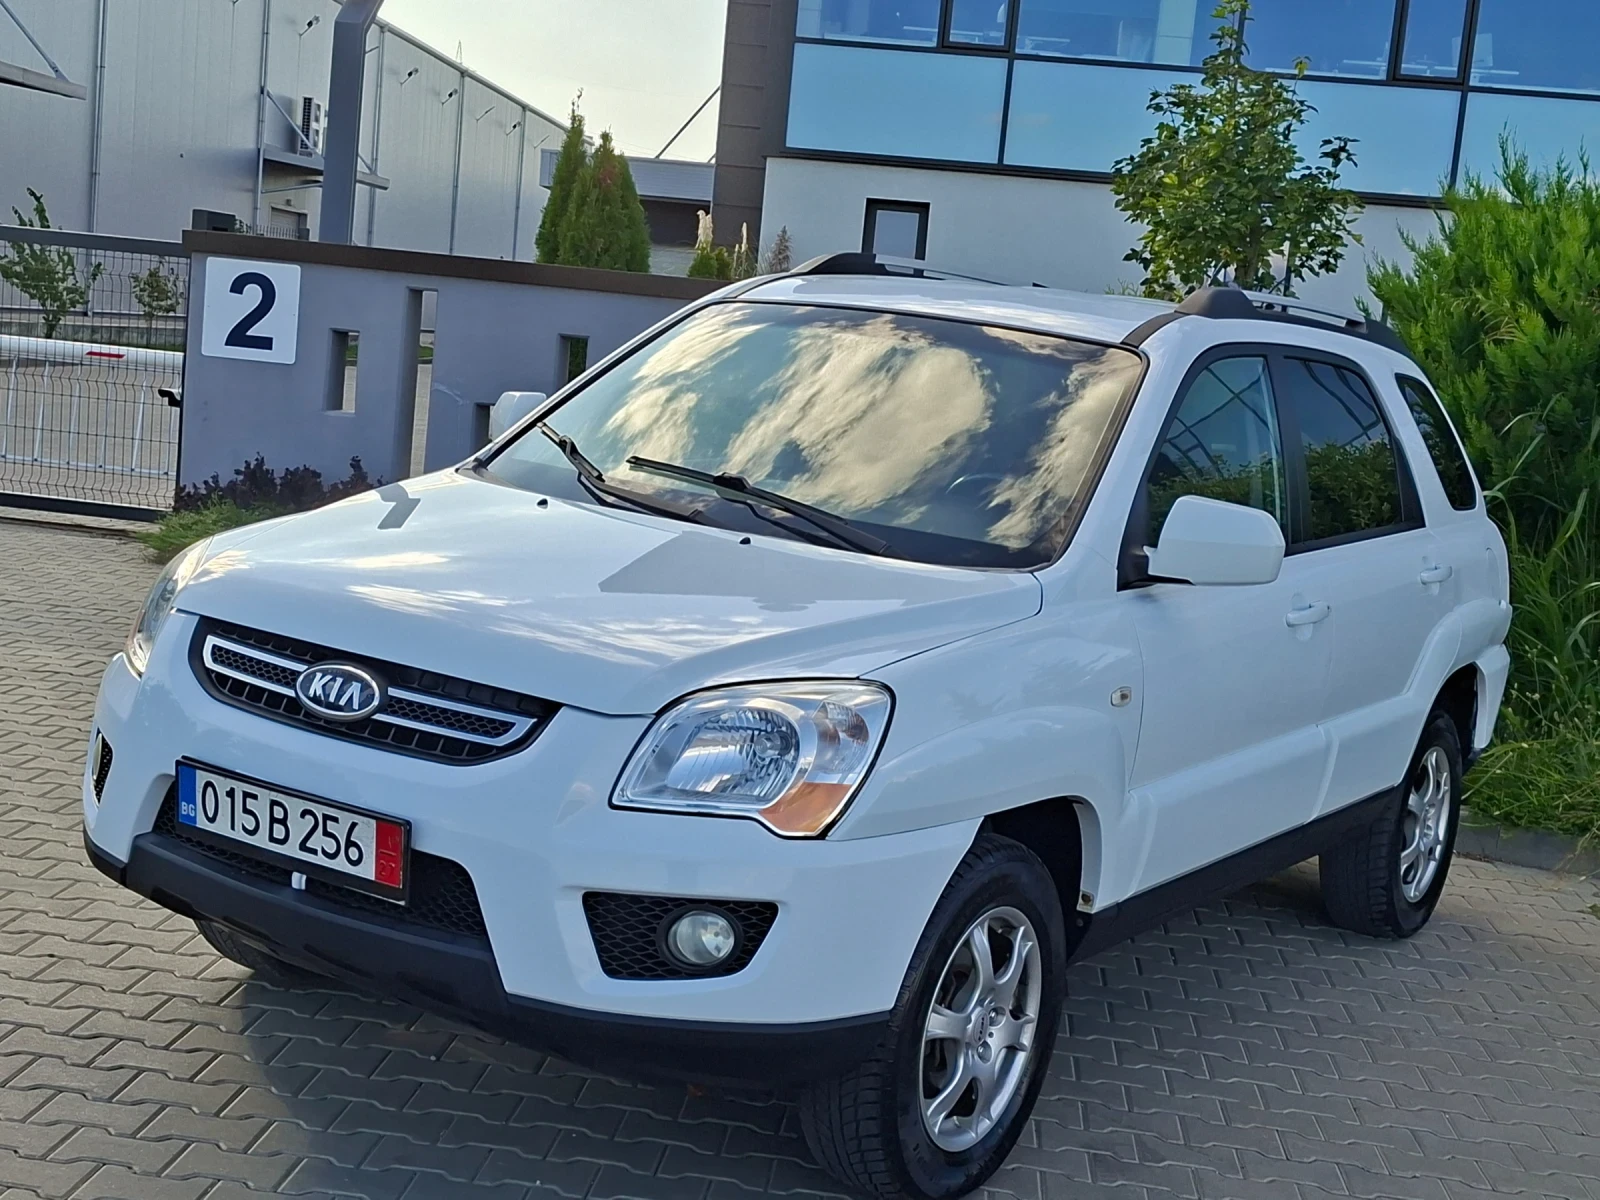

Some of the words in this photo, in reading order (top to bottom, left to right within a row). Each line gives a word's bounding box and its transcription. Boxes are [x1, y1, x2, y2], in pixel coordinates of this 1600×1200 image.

[224, 271, 277, 351] 2
[308, 672, 361, 710] KIA
[181, 801, 195, 817] BG
